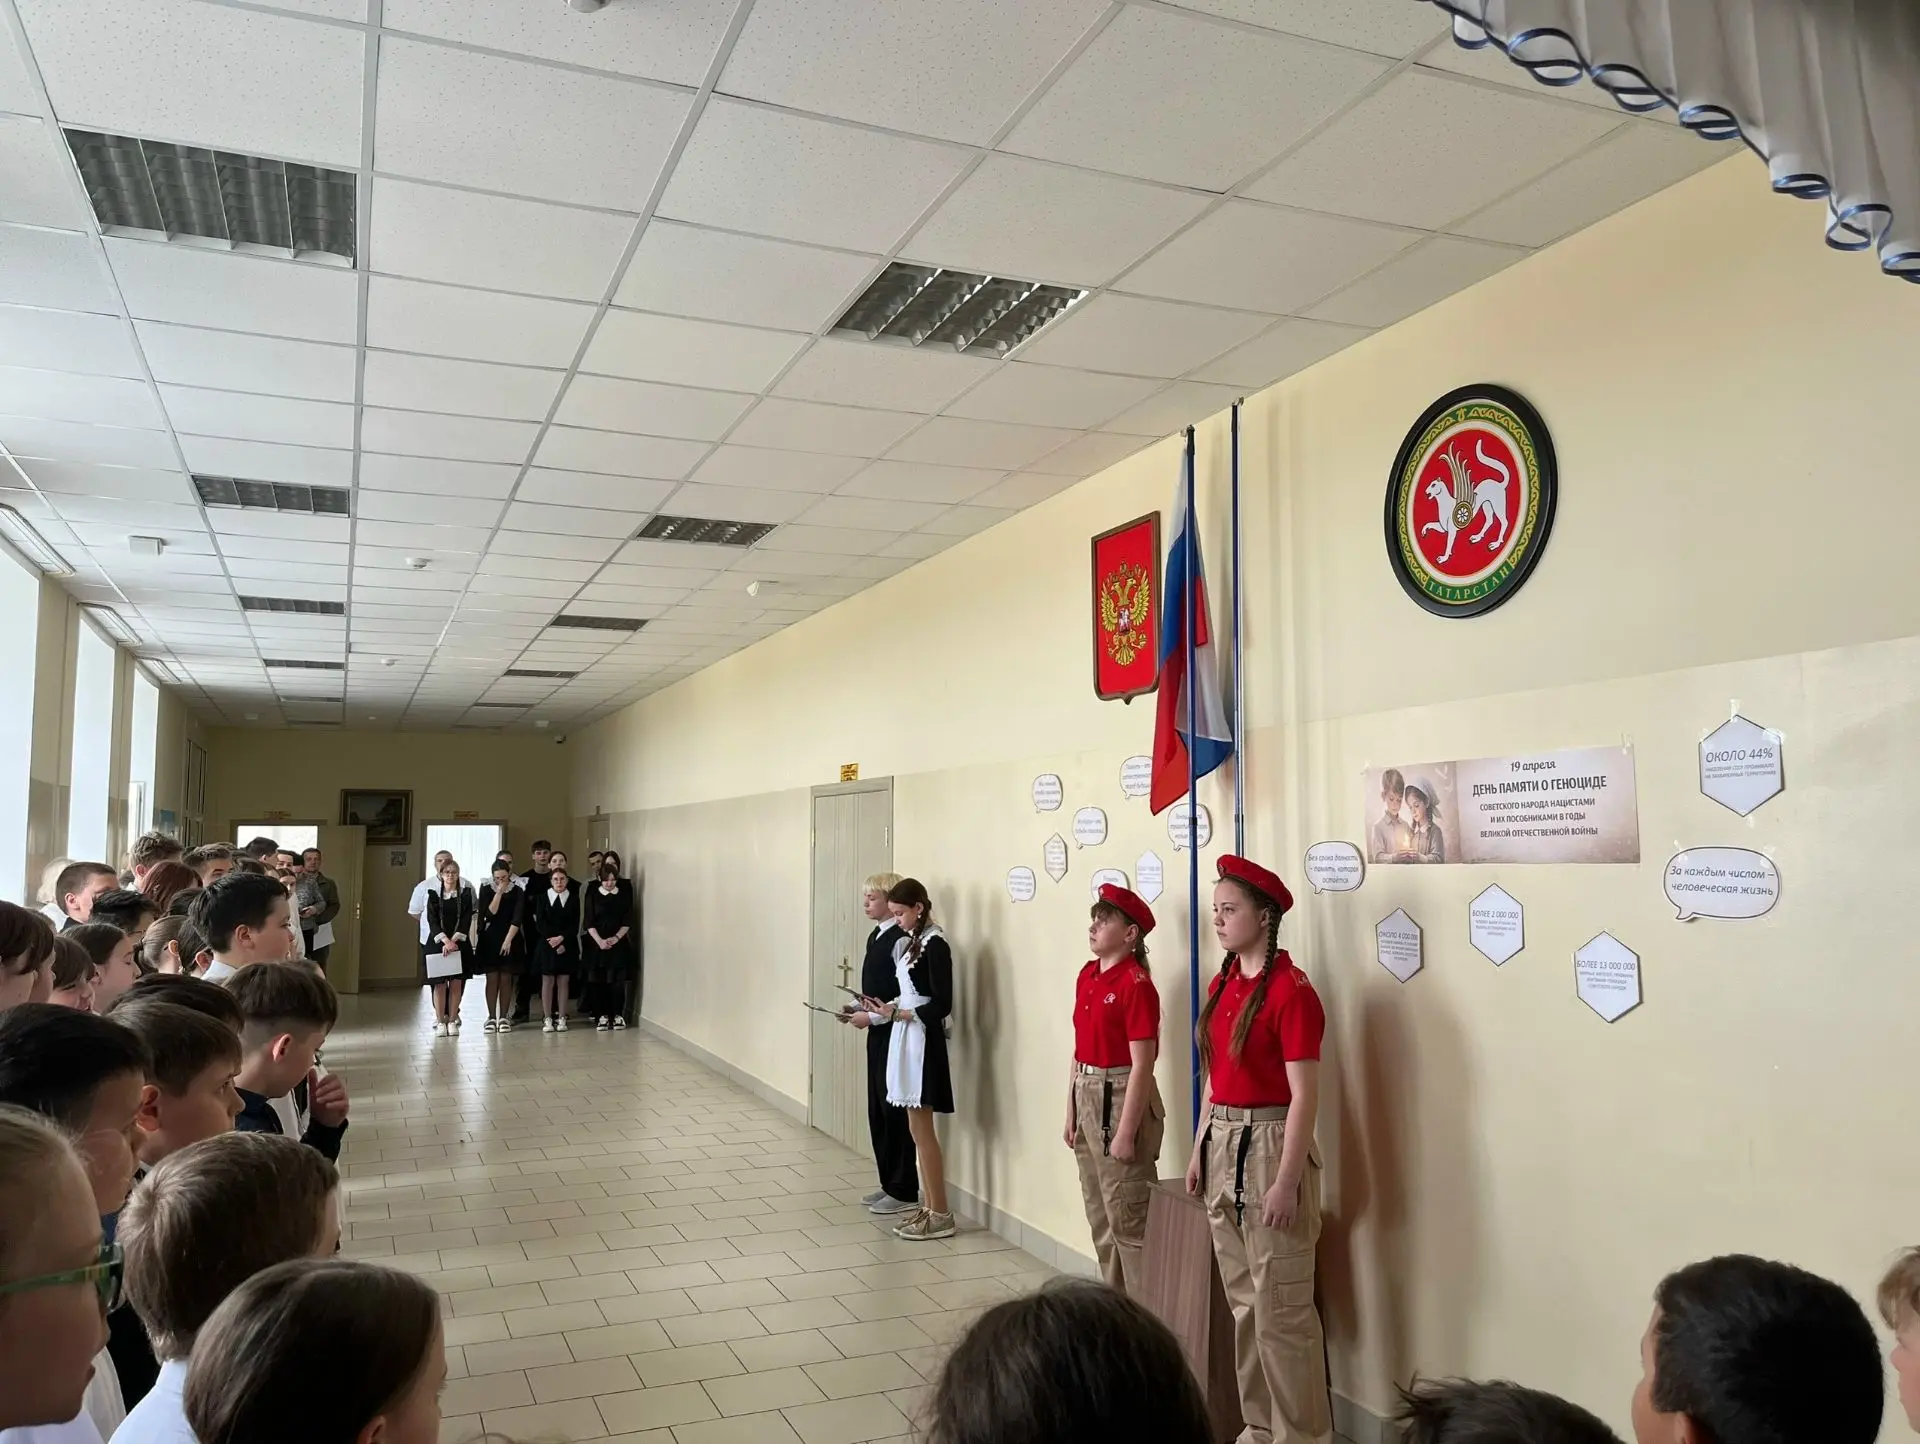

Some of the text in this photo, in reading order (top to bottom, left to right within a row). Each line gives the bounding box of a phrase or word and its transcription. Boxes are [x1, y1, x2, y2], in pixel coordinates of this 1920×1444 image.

[1428, 565, 1510, 600] ТАТАРСТАН
[1706, 747, 1773, 763] ОКОЛО 44%
[1511, 761, 1556, 773] 19 апреля
[1473, 775, 1607, 797] ДЕНЬ ПАМЯТИ О ГЕНОЦИДЕ
[1480, 798, 1596, 811] СОВЕТСКОГО НАРОДА НАЦИСТАМИ
[1506, 813, 1558, 823] ПОСОБНИКАМИ
[1559, 812, 1565, 821] В
[1565, 812, 1586, 821] ГОДЫ
[1480, 826, 1598, 838] ВЕЛИКОЙ ОТЕЧЕСТВЕННОЙ ВОЙНЫ
[1669, 865, 1682, 876] За
[1684, 866, 1726, 877] каждым
[1728, 871, 1766, 879] числом
[1671, 883, 1774, 896] человеческая жизнь
[1472, 909, 1519, 919] БОЛЕЕ 2 000 000
[1378, 931, 1398, 940] ОКОЛО
[1576, 960, 1636, 971] БОЛЕЕ 13 000 000
